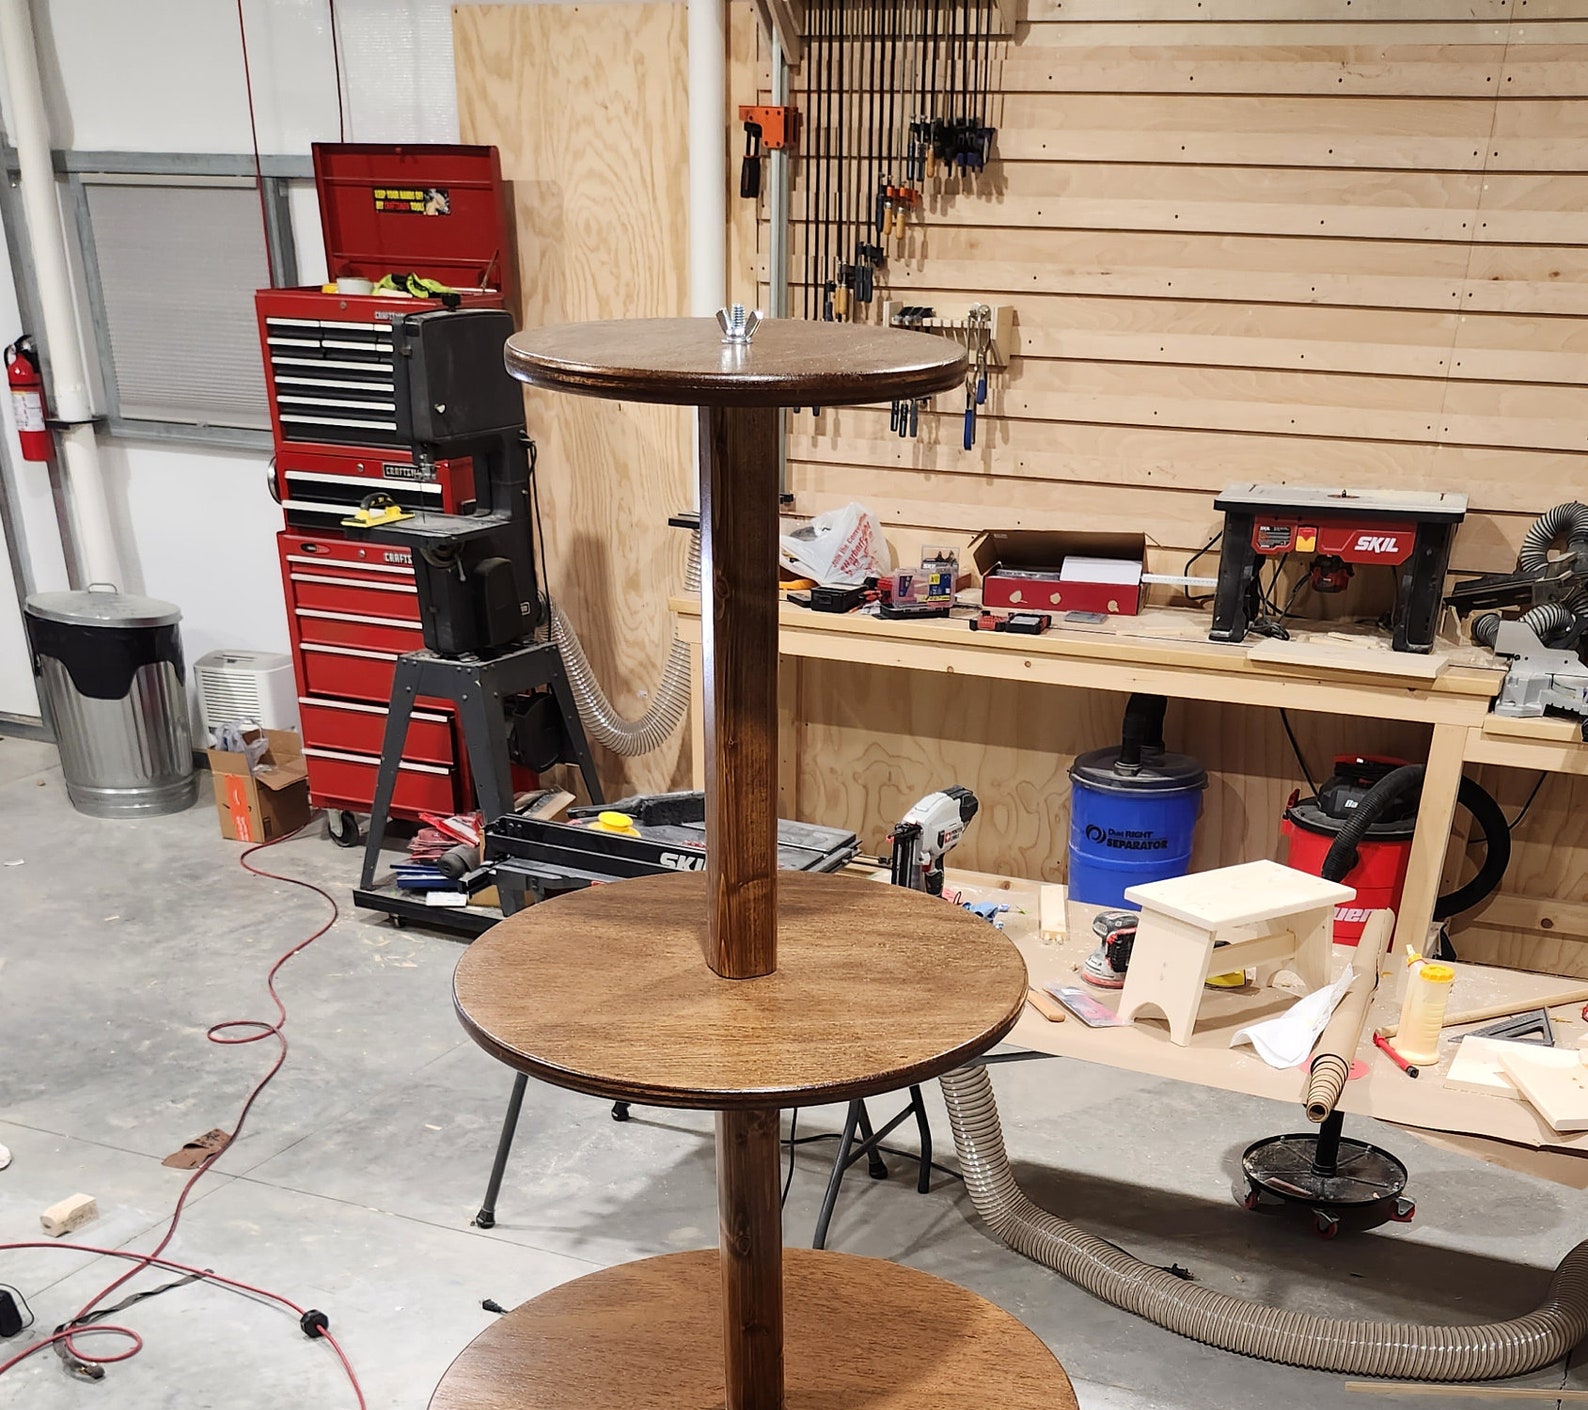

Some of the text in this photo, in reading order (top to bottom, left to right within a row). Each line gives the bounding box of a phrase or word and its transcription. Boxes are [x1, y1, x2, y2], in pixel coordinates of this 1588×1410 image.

[1354, 536, 1398, 553] SKIL
[384, 552, 412, 564] CRAFTS
[1125, 830, 1154, 839] RIGHT
[1106, 838, 1168, 850] SEPARATOR
[660, 852, 706, 871] SKI
